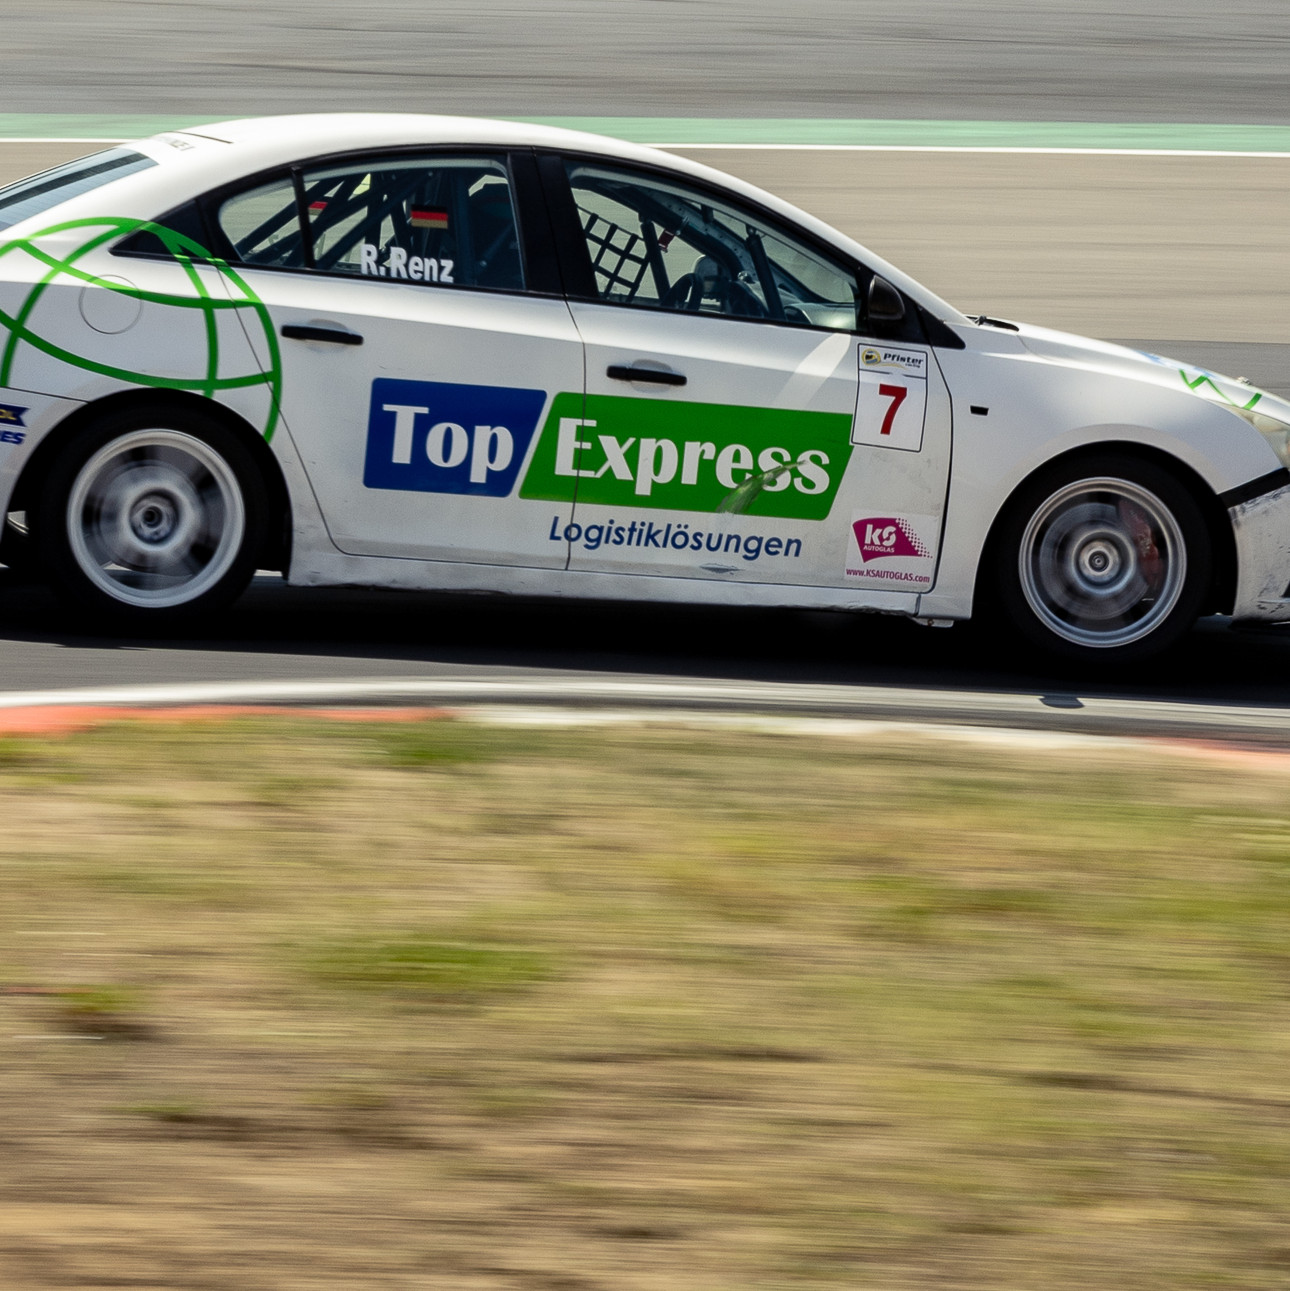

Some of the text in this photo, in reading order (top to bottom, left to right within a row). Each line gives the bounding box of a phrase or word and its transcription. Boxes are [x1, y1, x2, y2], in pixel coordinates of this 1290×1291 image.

[884, 353, 923, 365] Pfister
[878, 383, 908, 436] 7
[382, 404, 831, 497] Top Express
[548, 515, 803, 561] Logistiklösungen
[863, 545, 895, 553] AUTOGLAS
[846, 569, 930, 583] www.KSAUTOGLAS.com
